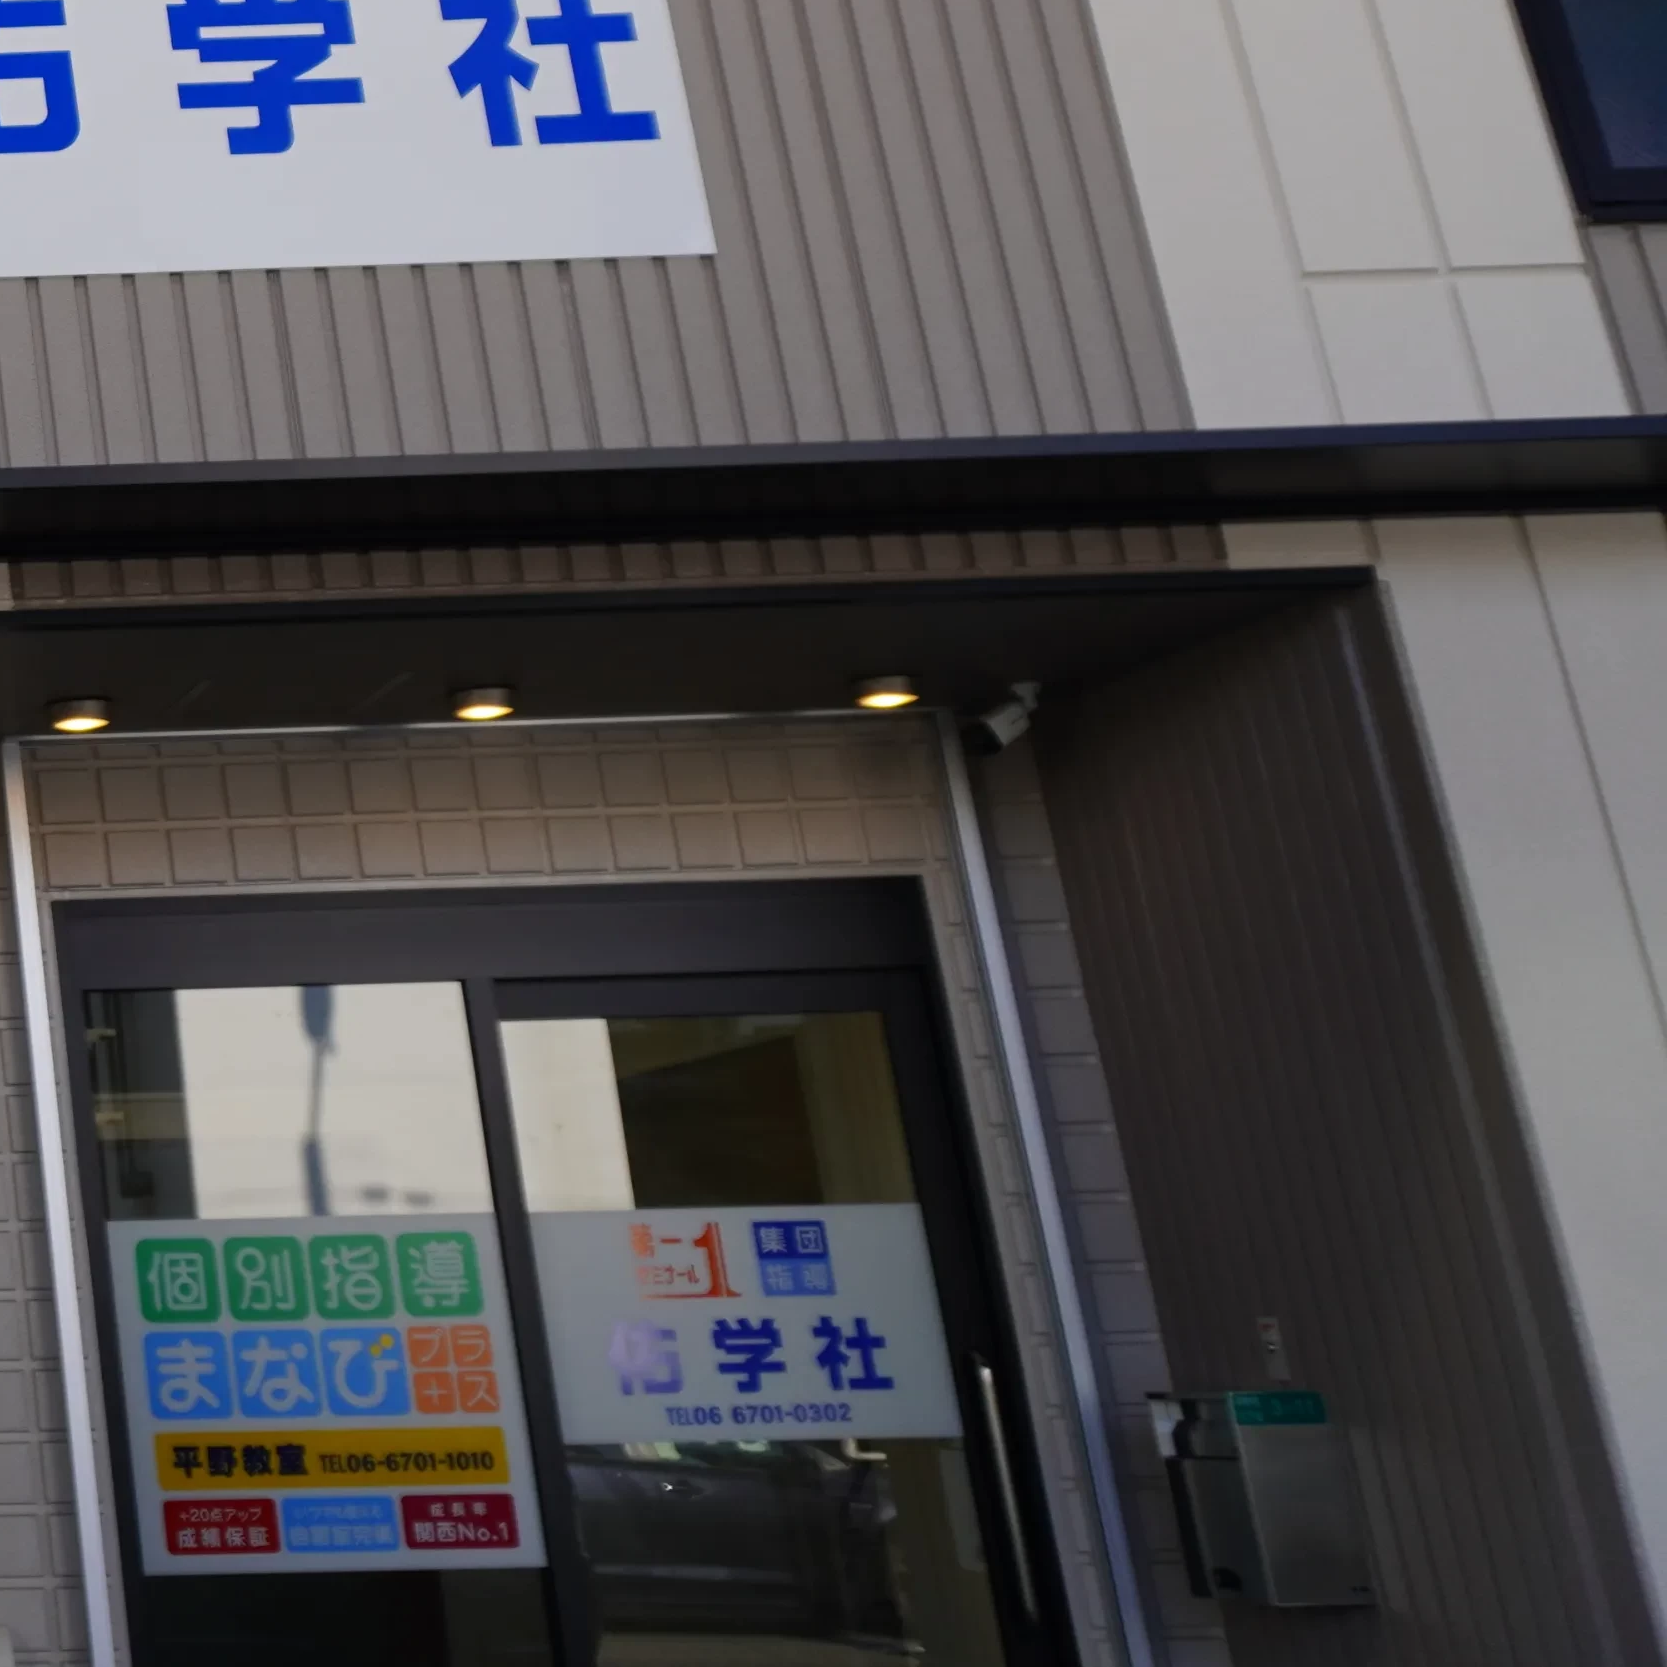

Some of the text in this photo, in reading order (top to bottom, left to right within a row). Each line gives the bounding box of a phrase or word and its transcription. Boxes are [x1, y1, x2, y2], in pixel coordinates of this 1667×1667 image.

[758, 1225, 824, 1255] 集団
[147, 1239, 470, 1313] 個別指導
[156, 1334, 404, 1413] まなび
[172, 1444, 309, 1479] 平野教室
